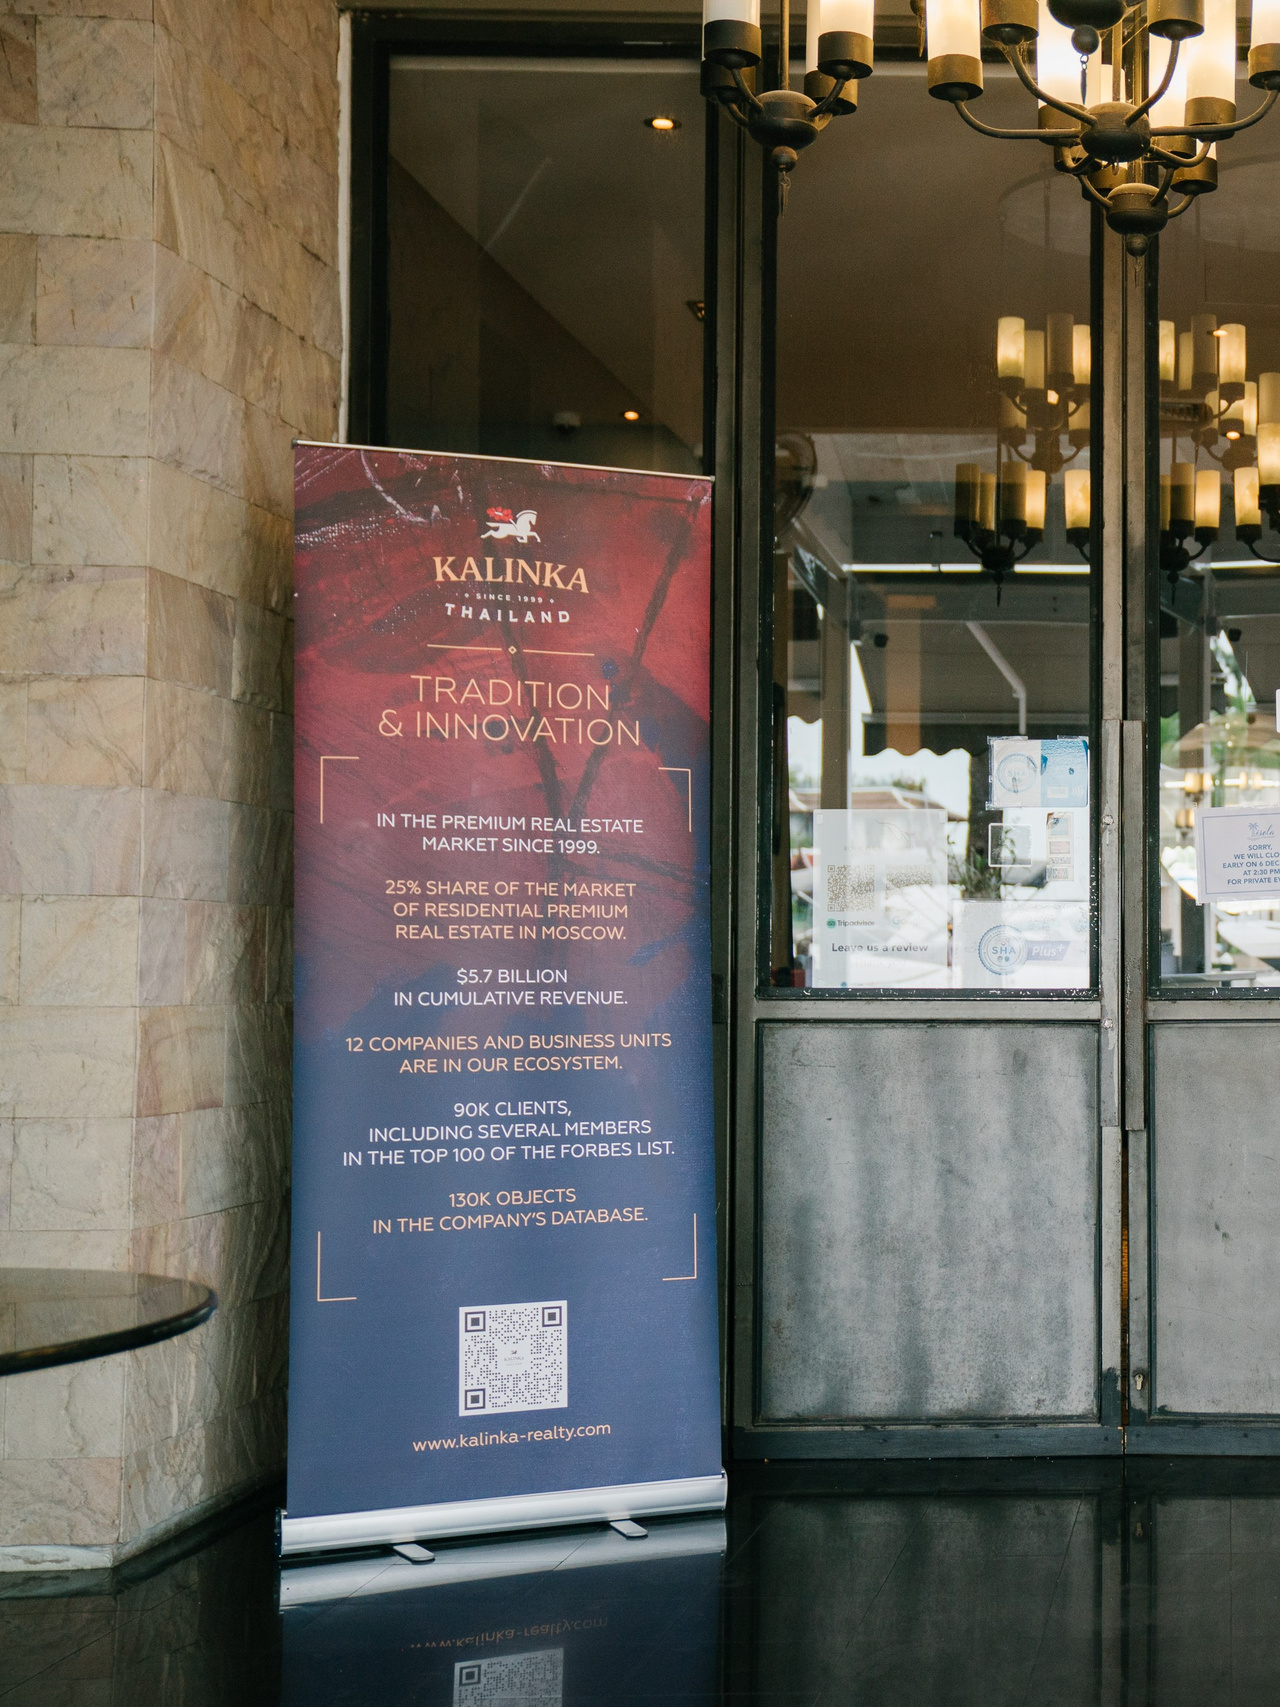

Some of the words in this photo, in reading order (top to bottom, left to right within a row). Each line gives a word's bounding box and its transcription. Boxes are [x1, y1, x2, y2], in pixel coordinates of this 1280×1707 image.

[433, 556, 590, 594] KALINKA
[476, 592, 510, 602] SINCE
[518, 594, 544, 604] 1999
[445, 603, 570, 624] THAILAND
[411, 675, 610, 711] TRADITION
[378, 710, 402, 737] &
[416, 710, 640, 746] INNOVATION
[377, 813, 394, 827] IN
[401, 814, 436, 828] THE
[442, 815, 525, 830] PREMIUM
[532, 817, 576, 832] REAL
[580, 818, 643, 833] ESTATE
[422, 837, 498, 851] MARKET
[502, 839, 554, 853] SINCE
[558, 840, 600, 854] 1999.
[386, 880, 421, 894] 25%
[426, 881, 488, 895] SHARE
[495, 882, 519, 895] OF
[525, 882, 558, 896] THE
[564, 883, 636, 897] MARKET
[393, 903, 419, 917] OF
[425, 903, 543, 918] RESIDENTIAL
[548, 904, 628, 918] PREMIUM
[396, 925, 443, 939] REAL
[449, 926, 513, 939] ESTATE
[520, 926, 536, 939] IN
[542, 926, 626, 940] MOSCOW.
[832, 943, 863, 952] Leave
[892, 943, 928, 952] review
[992, 946, 1016, 954] SHA
[457, 968, 492, 985] $5.7
[498, 970, 567, 983] BILLION
[394, 992, 412, 1006] IN
[418, 992, 535, 1006] CUMULATIVE
[540, 991, 628, 1005] REVENUE.
[346, 1038, 363, 1052] 12
[369, 1036, 478, 1051] COMPANIES
[484, 1035, 523, 1050] AND
[530, 1034, 614, 1048] BUSINESS
[620, 1033, 672, 1047] UNITS
[399, 1059, 438, 1073] ARE
[444, 1059, 461, 1072] IN
[467, 1058, 508, 1072] OUR
[514, 1056, 623, 1071] ECOSYSTEM.
[454, 1103, 490, 1117] 90K
[495, 1101, 572, 1116] CLIENTS,
[369, 1125, 472, 1142] INCLUDING
[478, 1123, 560, 1139] SEVERAL
[565, 1120, 651, 1136] MEMBERS
[344, 1152, 361, 1166] IN
[368, 1150, 404, 1165] THE
[410, 1149, 447, 1163] TOP
[453, 1148, 485, 1162] 100
[491, 1146, 515, 1161] OF
[521, 1145, 556, 1159] THE
[561, 1142, 632, 1158] FORBES
[637, 1141, 675, 1156] LIST.
[449, 1192, 490, 1207] 130K
[496, 1188, 576, 1206] OBJECTS
[373, 1219, 391, 1234] IN
[397, 1218, 434, 1232] THE
[552, 1208, 648, 1226] DATABASE.
[412, 1423, 611, 1452] www.kalinka-realty.com
